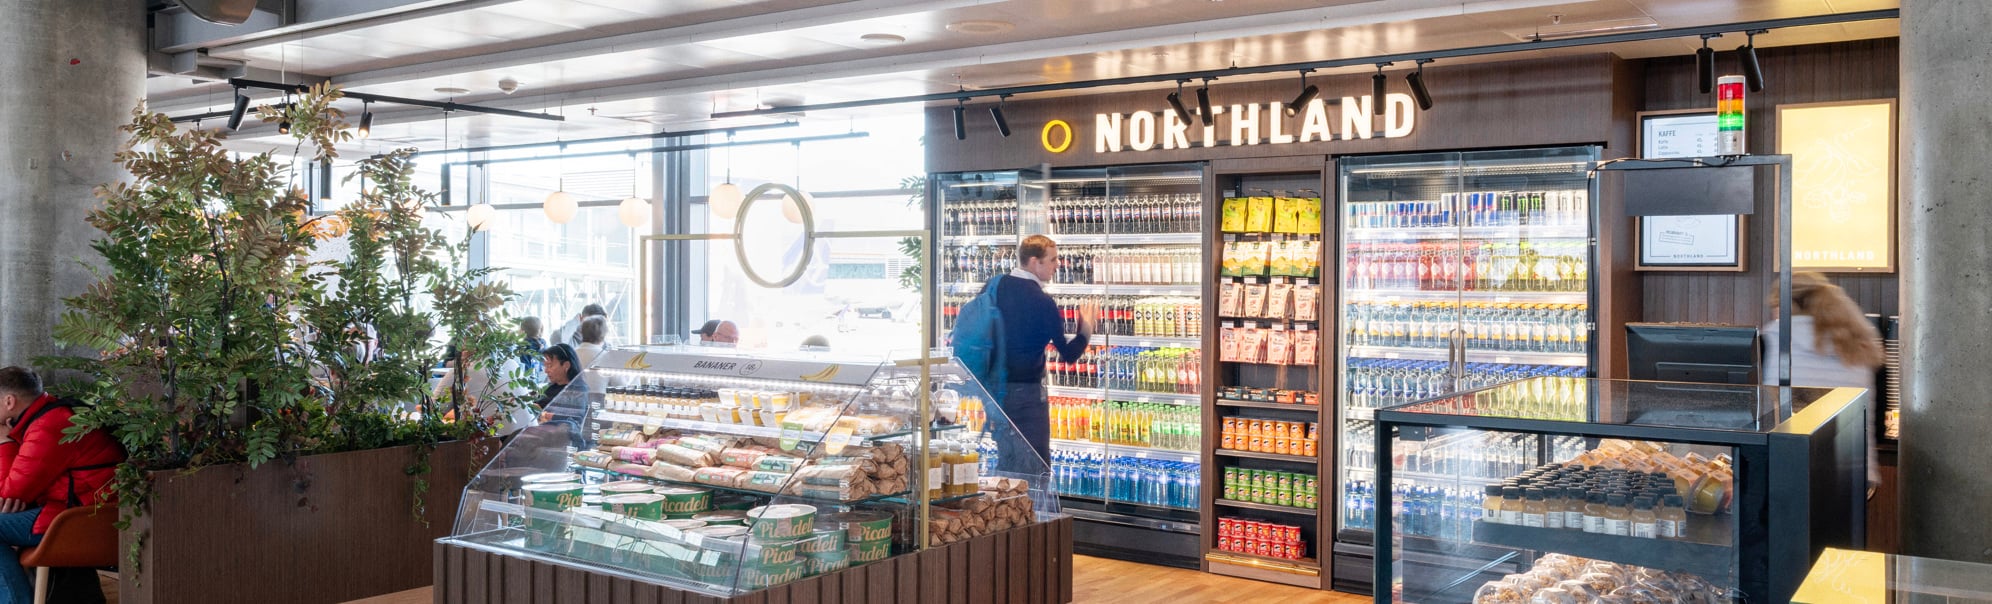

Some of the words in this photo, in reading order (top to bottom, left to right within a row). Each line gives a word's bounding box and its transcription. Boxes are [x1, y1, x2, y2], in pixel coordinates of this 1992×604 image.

[1095, 93, 1415, 153] NORTHLAND
[1795, 250, 1874, 261] NORTHLAND
[694, 361, 736, 370] BANANER
